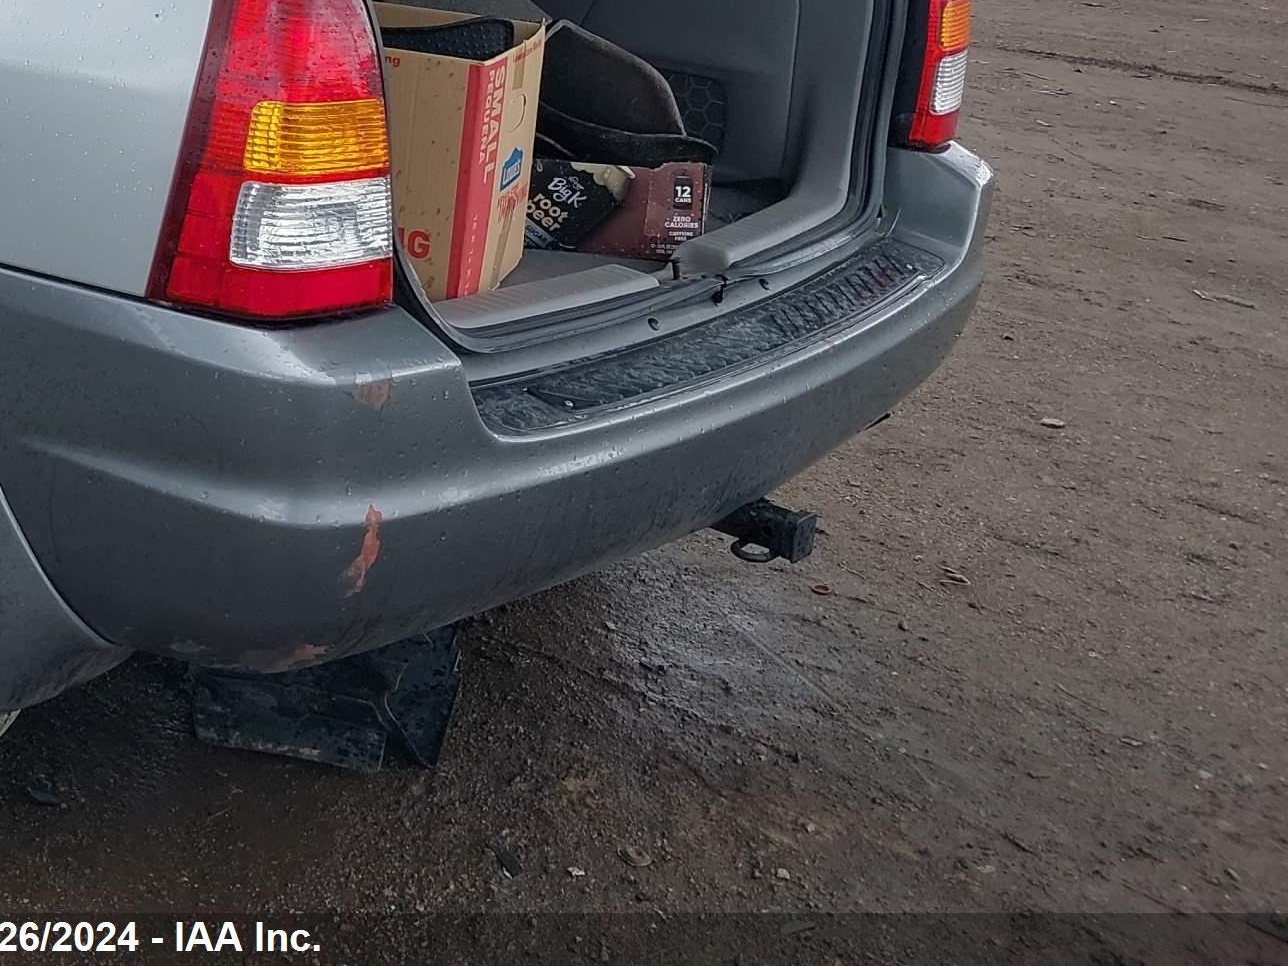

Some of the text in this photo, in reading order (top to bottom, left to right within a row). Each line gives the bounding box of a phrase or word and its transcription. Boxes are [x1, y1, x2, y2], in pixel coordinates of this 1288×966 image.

[482, 65, 506, 184] SMALL
[547, 177, 572, 202] Big
[675, 185, 692, 198] 12
[525, 199, 561, 232] beer
[533, 193, 569, 223] root
